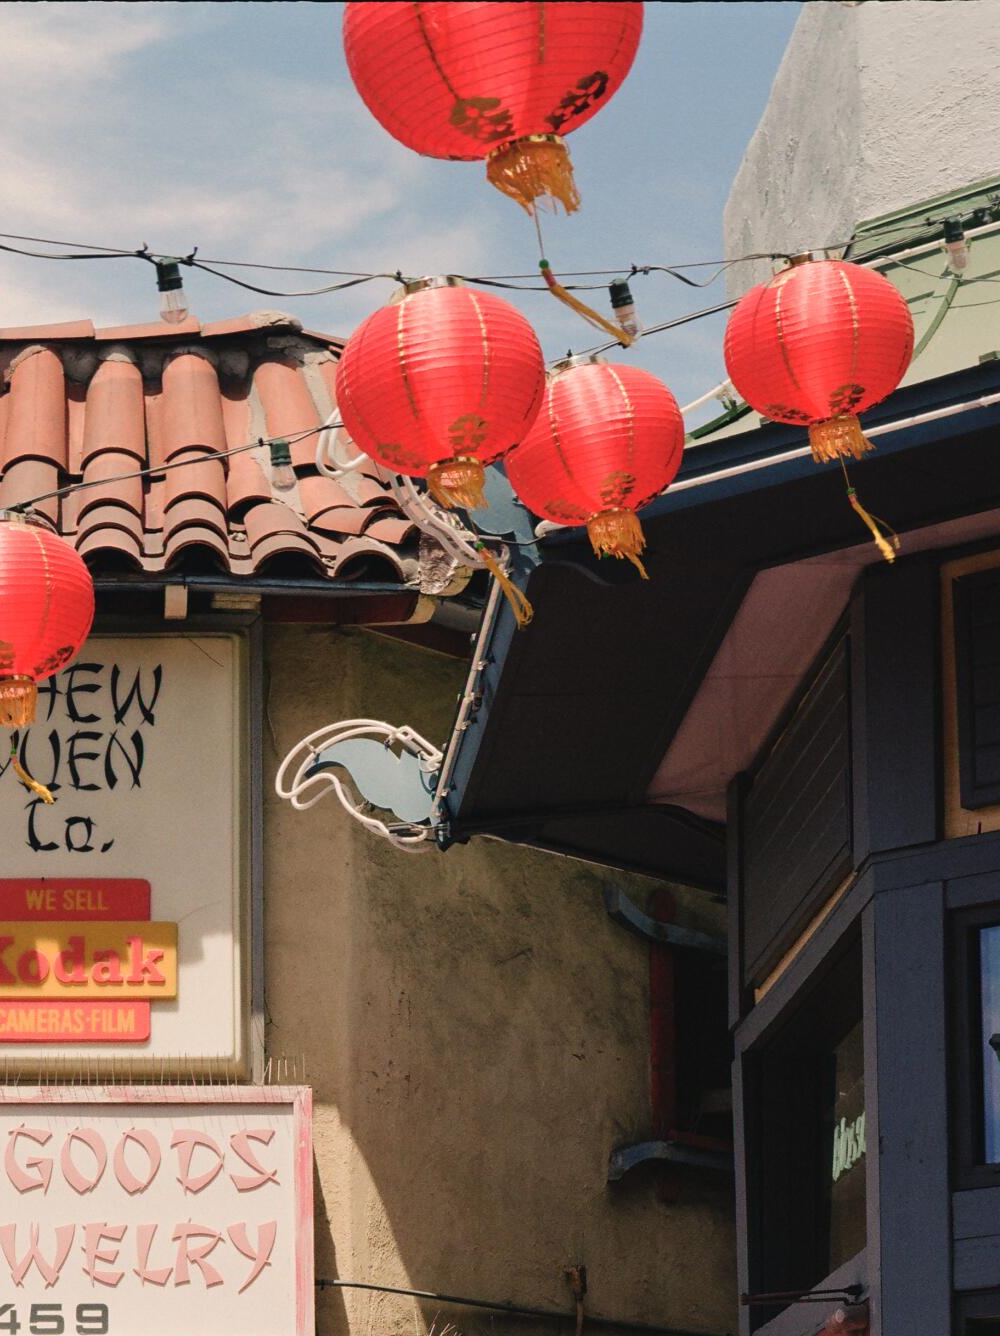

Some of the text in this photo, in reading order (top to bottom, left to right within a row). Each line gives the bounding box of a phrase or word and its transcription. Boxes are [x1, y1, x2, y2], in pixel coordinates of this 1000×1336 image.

[24, 797, 115, 853] Co.
[26, 889, 109, 911] WE SELL
[3, 1122, 281, 1196] GOODS
